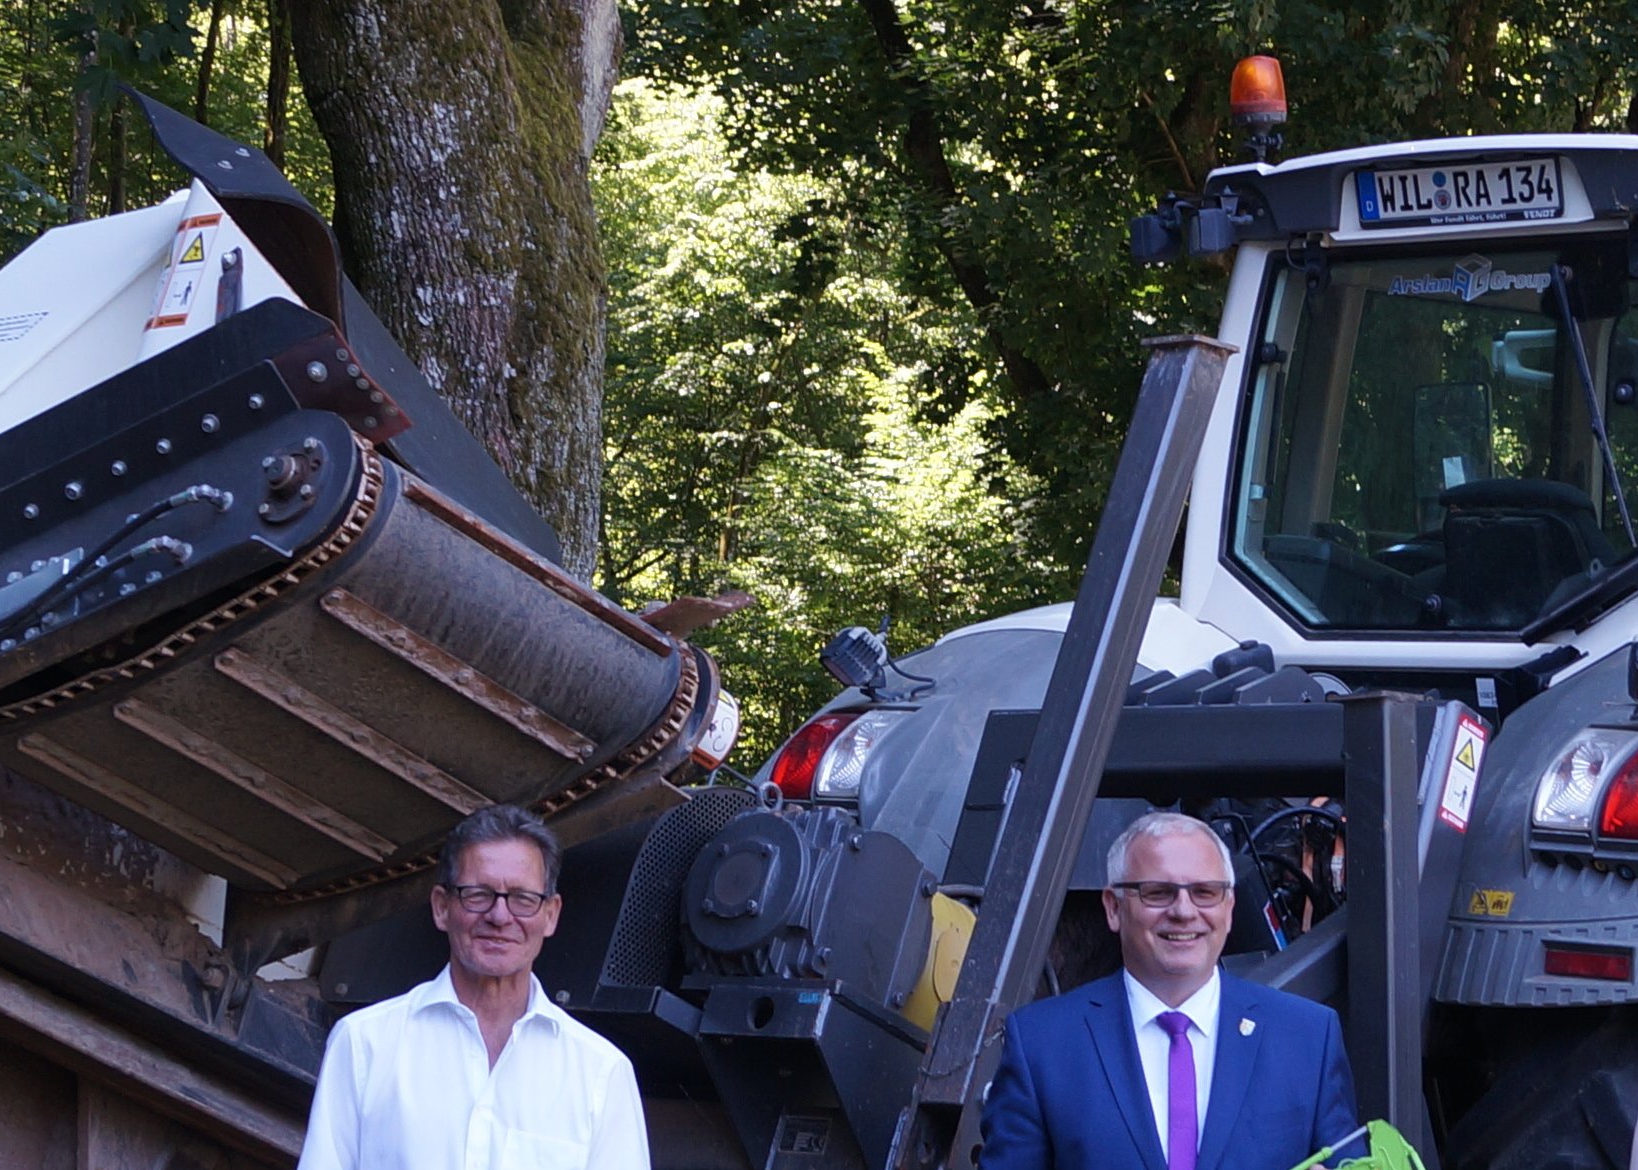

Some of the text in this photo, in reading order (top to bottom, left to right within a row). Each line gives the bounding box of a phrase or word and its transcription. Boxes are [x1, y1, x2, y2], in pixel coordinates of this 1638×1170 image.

[1378, 173, 1433, 213] WIL
[1453, 169, 1492, 209] RA
[1498, 163, 1554, 205] 134
[1523, 209, 1556, 219] FENDT
[1388, 273, 1452, 295] Arslan
[1490, 270, 1552, 293] Group
